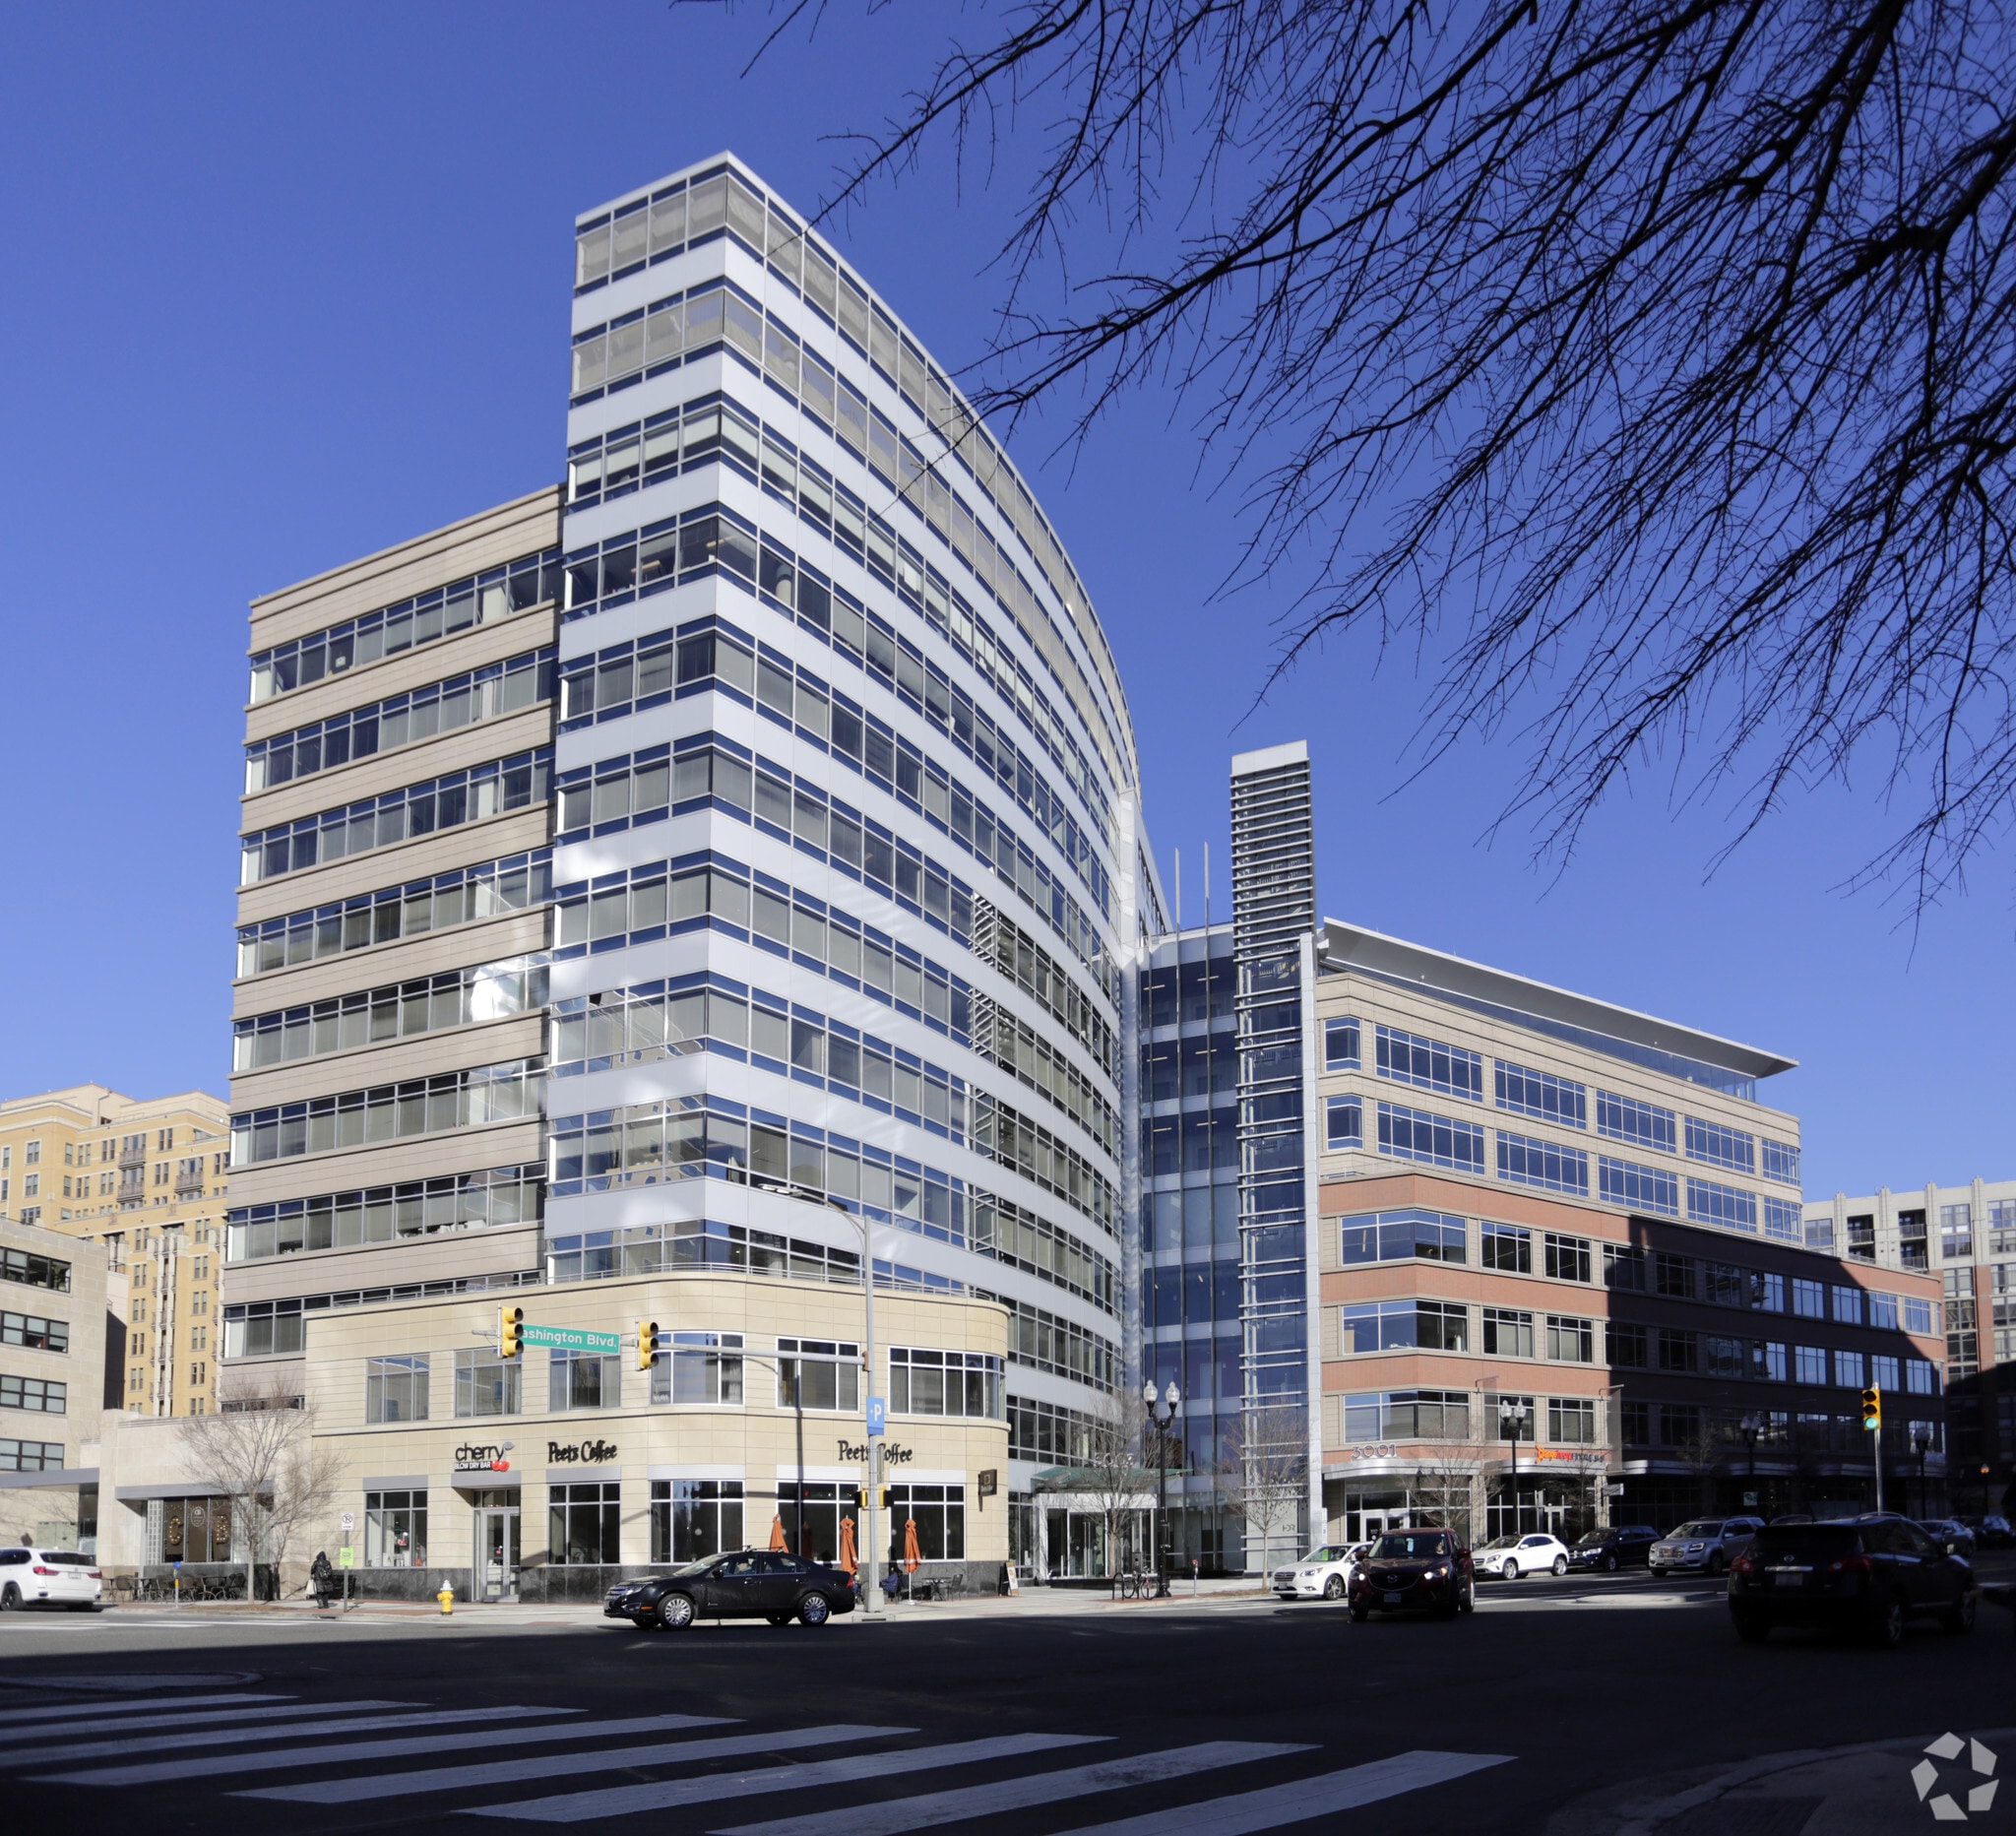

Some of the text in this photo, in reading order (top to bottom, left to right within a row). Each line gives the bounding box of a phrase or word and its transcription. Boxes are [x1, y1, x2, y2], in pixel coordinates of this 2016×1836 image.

[522, 1329, 617, 1348] ashington Blvd.
[873, 1403, 882, 1422] P
[455, 1442, 504, 1461] cherry
[546, 1439, 618, 1464] Peet's Coffee
[1351, 1442, 1397, 1461] 3001
